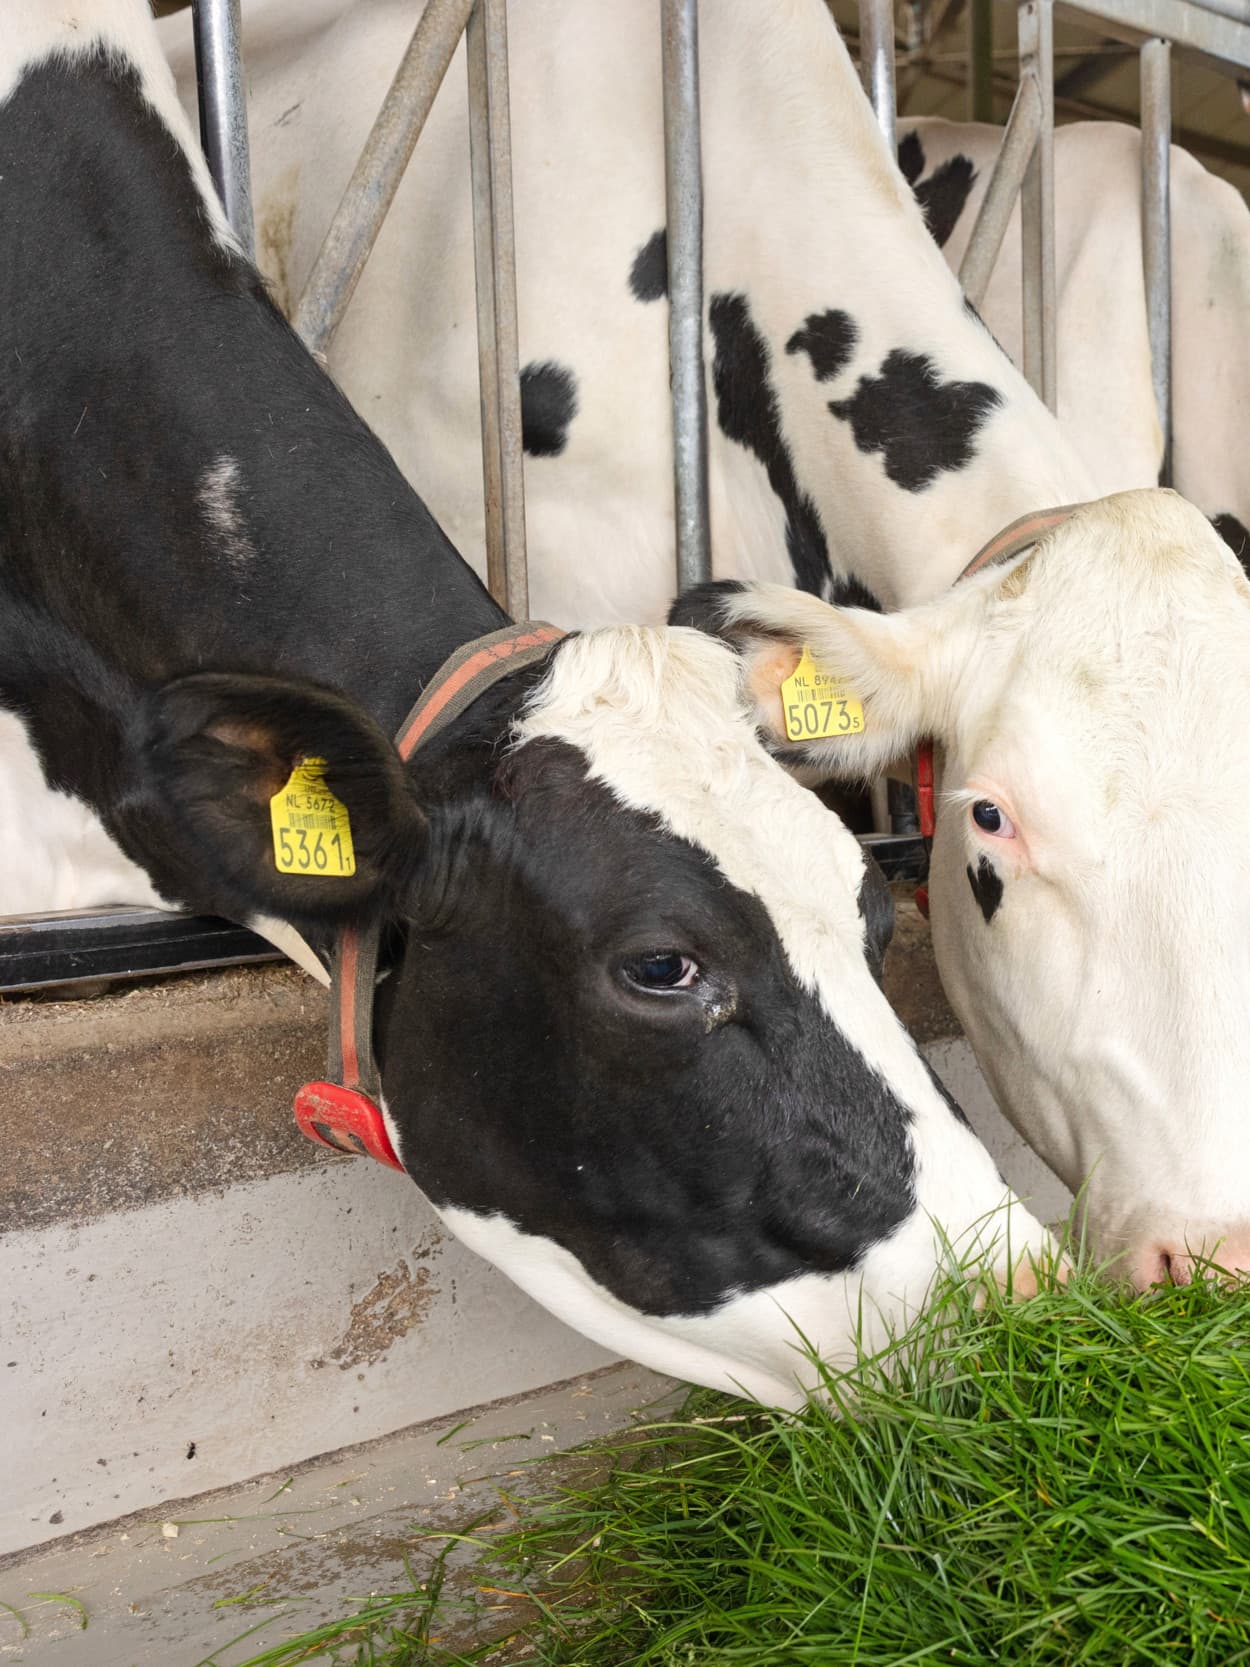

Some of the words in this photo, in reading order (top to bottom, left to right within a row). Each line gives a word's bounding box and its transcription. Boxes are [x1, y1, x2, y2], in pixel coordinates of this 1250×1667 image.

[794, 676, 809, 688] NL
[788, 700, 851, 736] 5073
[286, 793, 301, 809] NL
[306, 795, 336, 813] 5672
[279, 827, 343, 871] 5361
